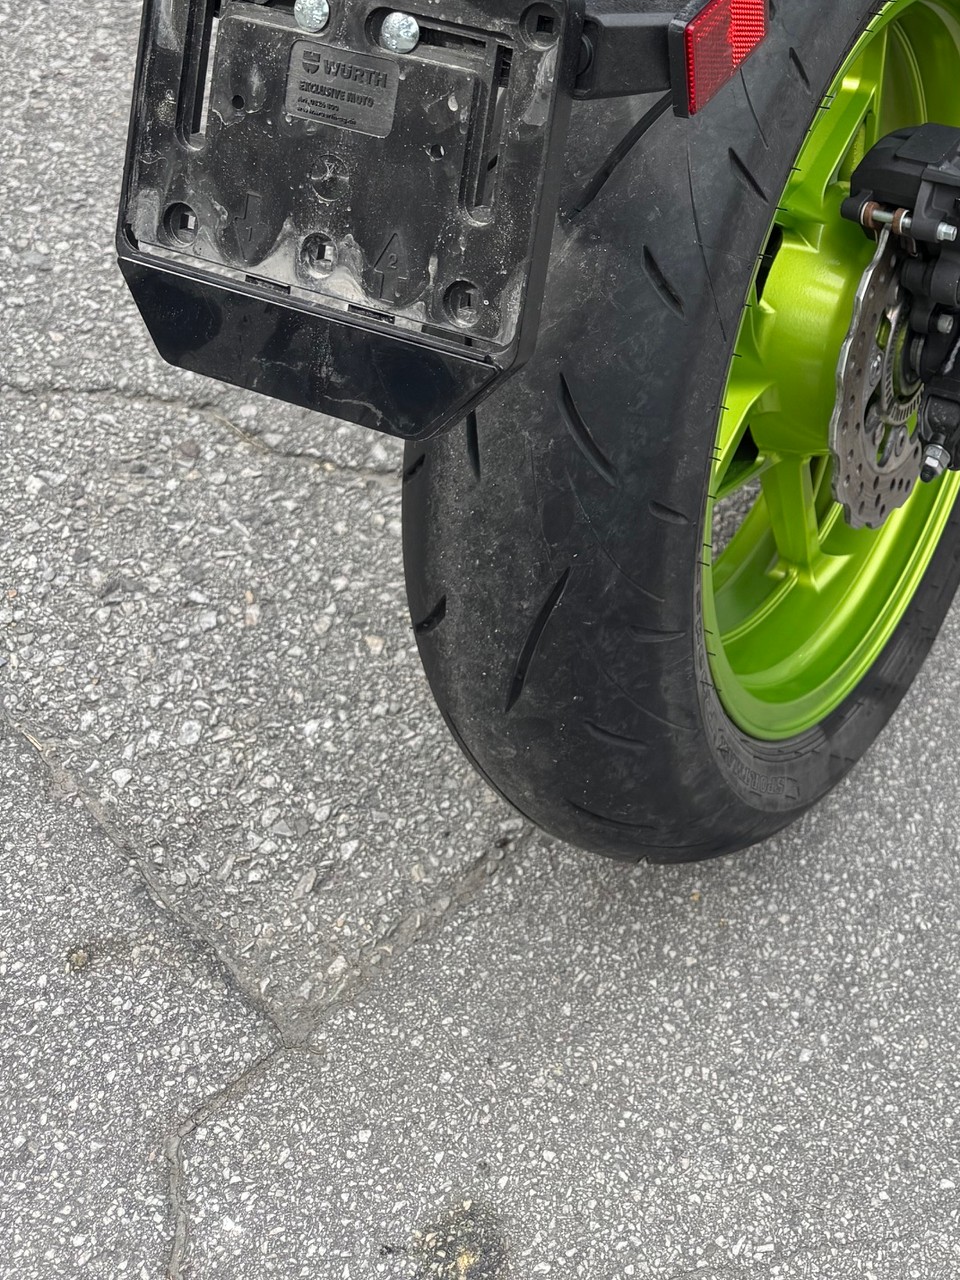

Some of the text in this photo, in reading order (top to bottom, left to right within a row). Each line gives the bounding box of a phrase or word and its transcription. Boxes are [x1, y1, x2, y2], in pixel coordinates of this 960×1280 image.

[299, 81, 346, 101] EXCLUSIVE
[347, 91, 375, 108] MOTO
[388, 253, 398, 269] 2
